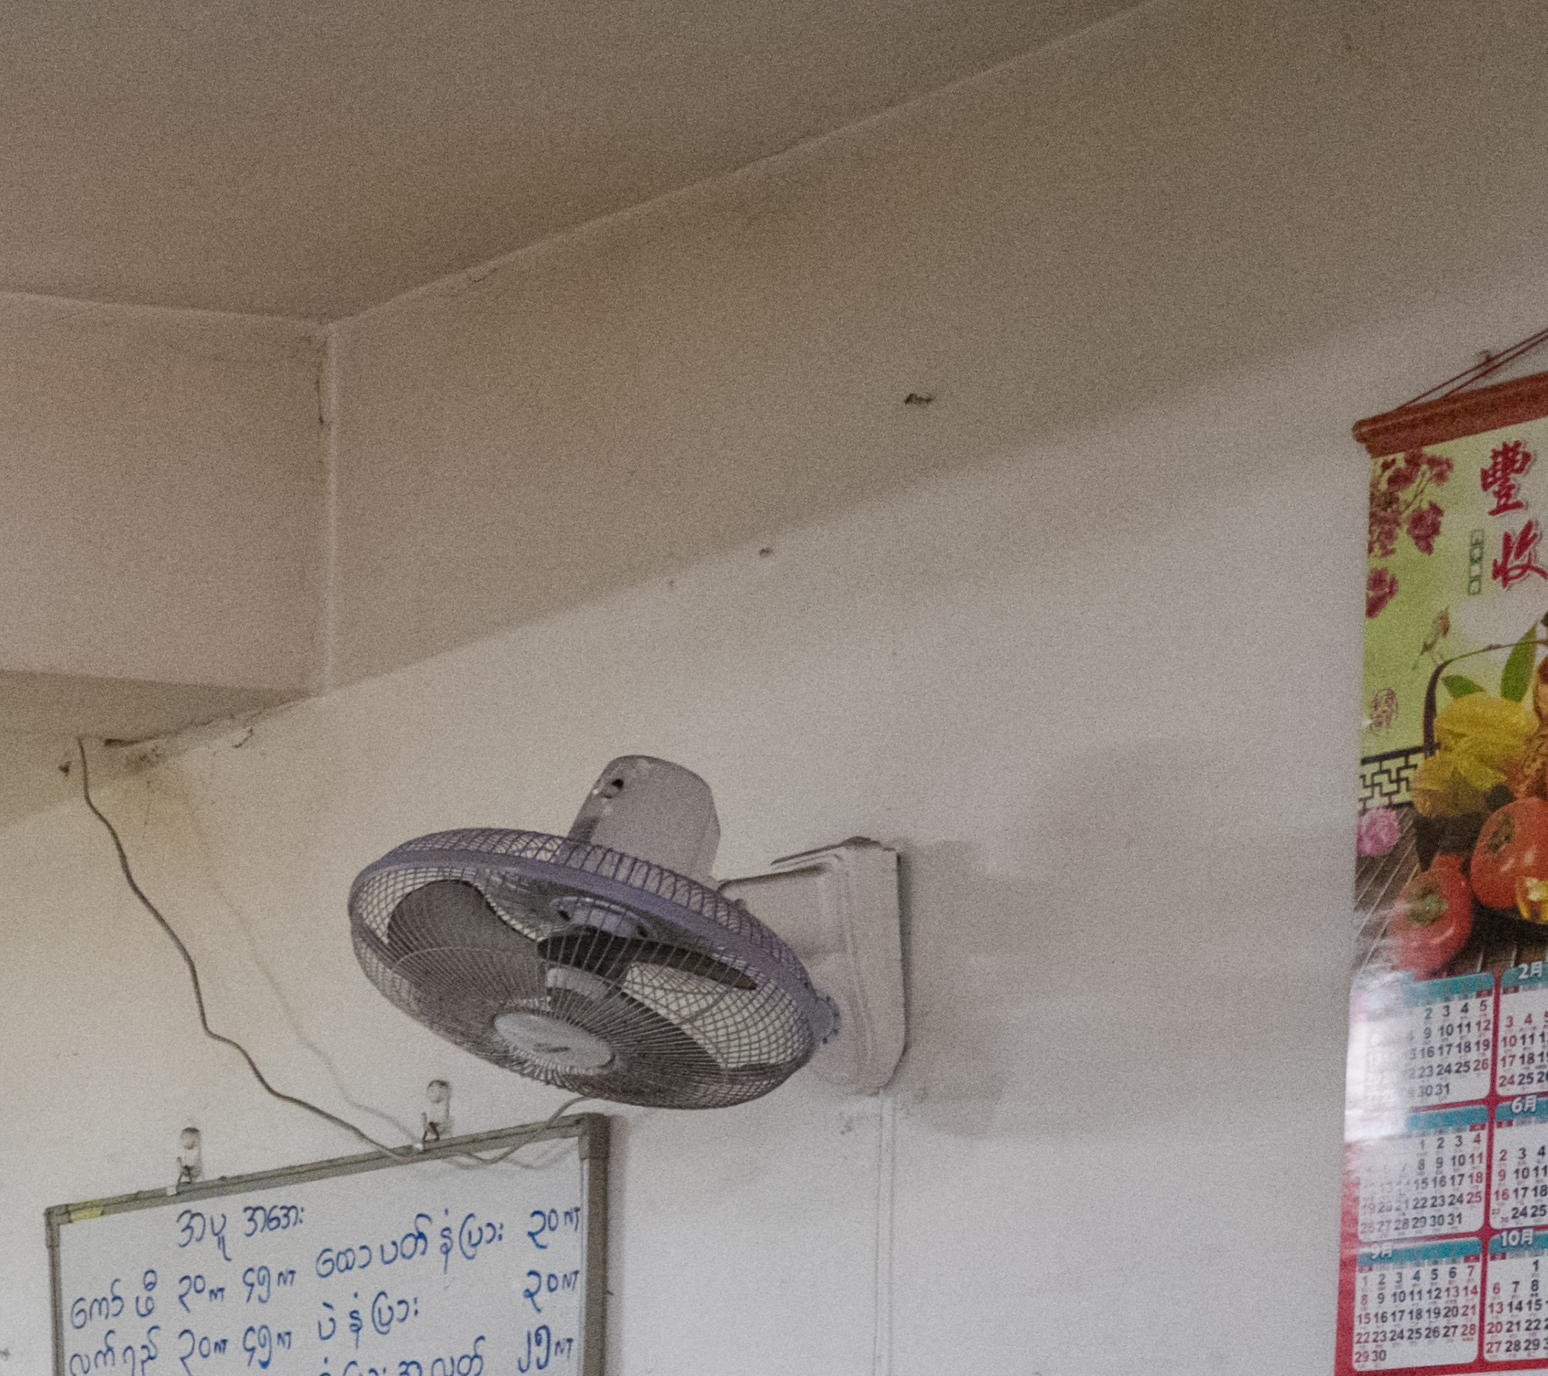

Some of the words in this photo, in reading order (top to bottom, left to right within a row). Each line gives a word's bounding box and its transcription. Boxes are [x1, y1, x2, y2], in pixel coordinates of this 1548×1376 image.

[1518, 961, 1542, 979] 2月
[1511, 1095, 1536, 1113] 6月
[1499, 1149, 1507, 1162] 2
[1519, 1148, 1526, 1160] 3
[1538, 1146, 1545, 1157] 4
[1498, 1169, 1506, 1182] 9
[1514, 1167, 1530, 1179] 10
[1534, 1165, 1548, 1177] 11
[1413, 1197, 1428, 1210] 22
[1430, 1195, 1445, 1208] 23
[1448, 1194, 1464, 1206] 24
[1467, 1191, 1484, 1204] 25
[1495, 1189, 1509, 1200] 16
[1513, 1186, 1529, 1198] 17
[1533, 1185, 1548, 1197] 18
[1512, 1207, 1528, 1219] 24
[1531, 1204, 1547, 1218] 25
[1501, 1229, 1534, 1248] 10月
[1533, 1260, 1539, 1271] 1
[1363, 1276, 1368, 1289] 1
[1378, 1274, 1385, 1287] 2
[1396, 1272, 1403, 1285] 3
[1413, 1271, 1420, 1281] 4
[1431, 1268, 1438, 1281] 5
[1449, 1267, 1456, 1279] 6
[1467, 1264, 1475, 1277] 7
[1493, 1283, 1500, 1295] 6
[1512, 1280, 1520, 1293] 7
[1531, 1279, 1539, 1293] 8
[1361, 1294, 1368, 1306] 8
[1377, 1292, 1385, 1304] 9
[1392, 1290, 1406, 1302] 10
[1409, 1290, 1422, 1300] 11
[1427, 1287, 1442, 1300] 12
[1445, 1286, 1459, 1298] 13
[1464, 1285, 1480, 1296] 14
[1486, 1302, 1503, 1314] 13
[1508, 1301, 1523, 1312] 14
[1527, 1298, 1542, 1311] 15
[1358, 1313, 1371, 1324] 15
[1374, 1312, 1387, 1323] 16
[1391, 1309, 1405, 1321] 17
[1409, 1309, 1422, 1320] 18
[1426, 1307, 1441, 1318] 19
[1443, 1305, 1459, 1318] 20
[1462, 1305, 1476, 1317] 21
[1353, 1332, 1369, 1344] 22
[1372, 1330, 1387, 1344] 23
[1390, 1329, 1404, 1342] 24
[1407, 1328, 1422, 1340] 25
[1425, 1327, 1440, 1339] 26
[1443, 1325, 1458, 1338] 27
[1462, 1324, 1478, 1336] 28
[1485, 1321, 1503, 1334] 20
[1506, 1321, 1521, 1333] 21
[1525, 1319, 1541, 1331] 22
[1484, 1341, 1501, 1354] 27
[1505, 1340, 1521, 1353] 28
[1524, 1338, 1540, 1351] 29
[1353, 1351, 1369, 1363] 29
[1373, 1349, 1386, 1362] 30
